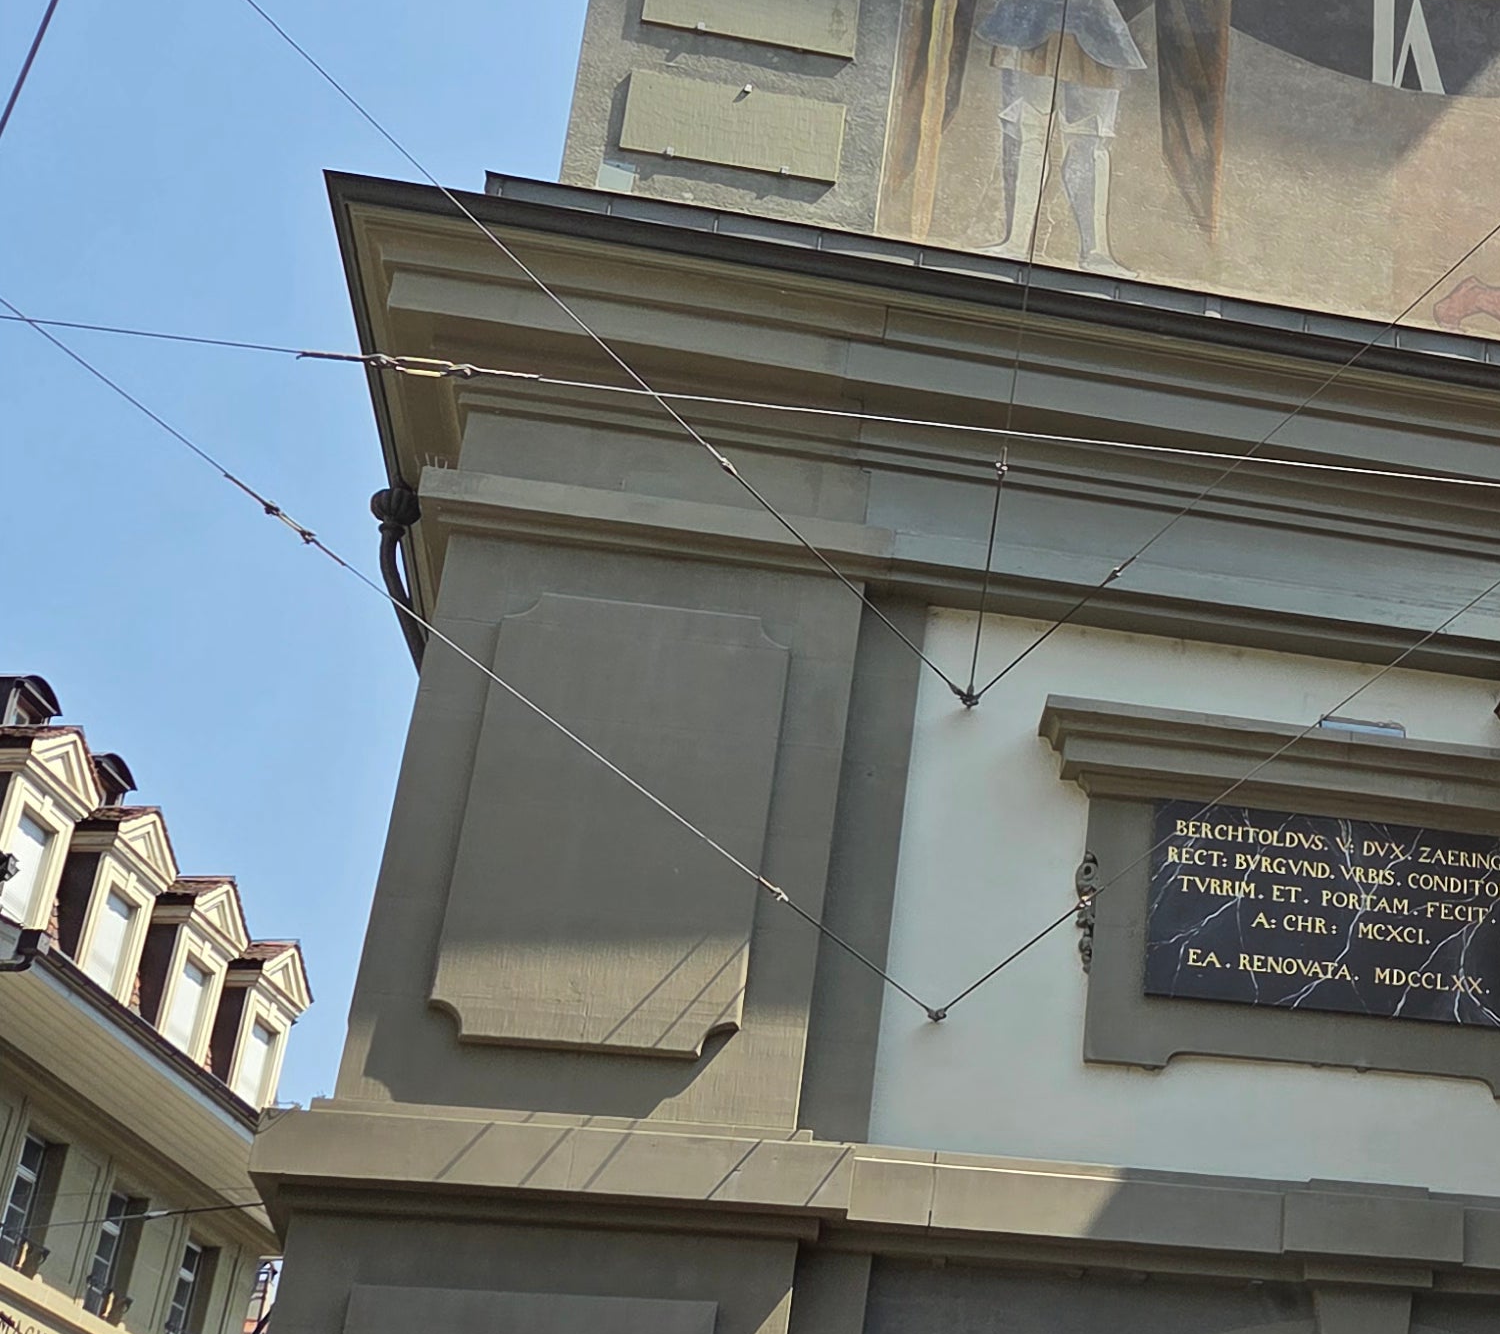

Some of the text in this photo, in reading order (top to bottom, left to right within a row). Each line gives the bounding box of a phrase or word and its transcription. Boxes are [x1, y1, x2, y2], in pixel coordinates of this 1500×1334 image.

[1175, 820, 1329, 851] BERCHTOLDVS.
[1363, 840, 1412, 860] DVX.
[1167, 846, 1228, 868] RECT:
[1234, 855, 1336, 880] BVRGVND.
[1340, 865, 1402, 888] VRBIS.
[1251, 912, 1431, 946] A: CHR: MCXCI.
[1426, 902, 1496, 925] FECIT.
[1238, 954, 1359, 983] RENOVATA.
[1374, 967, 1491, 995] MDCCLXX.
